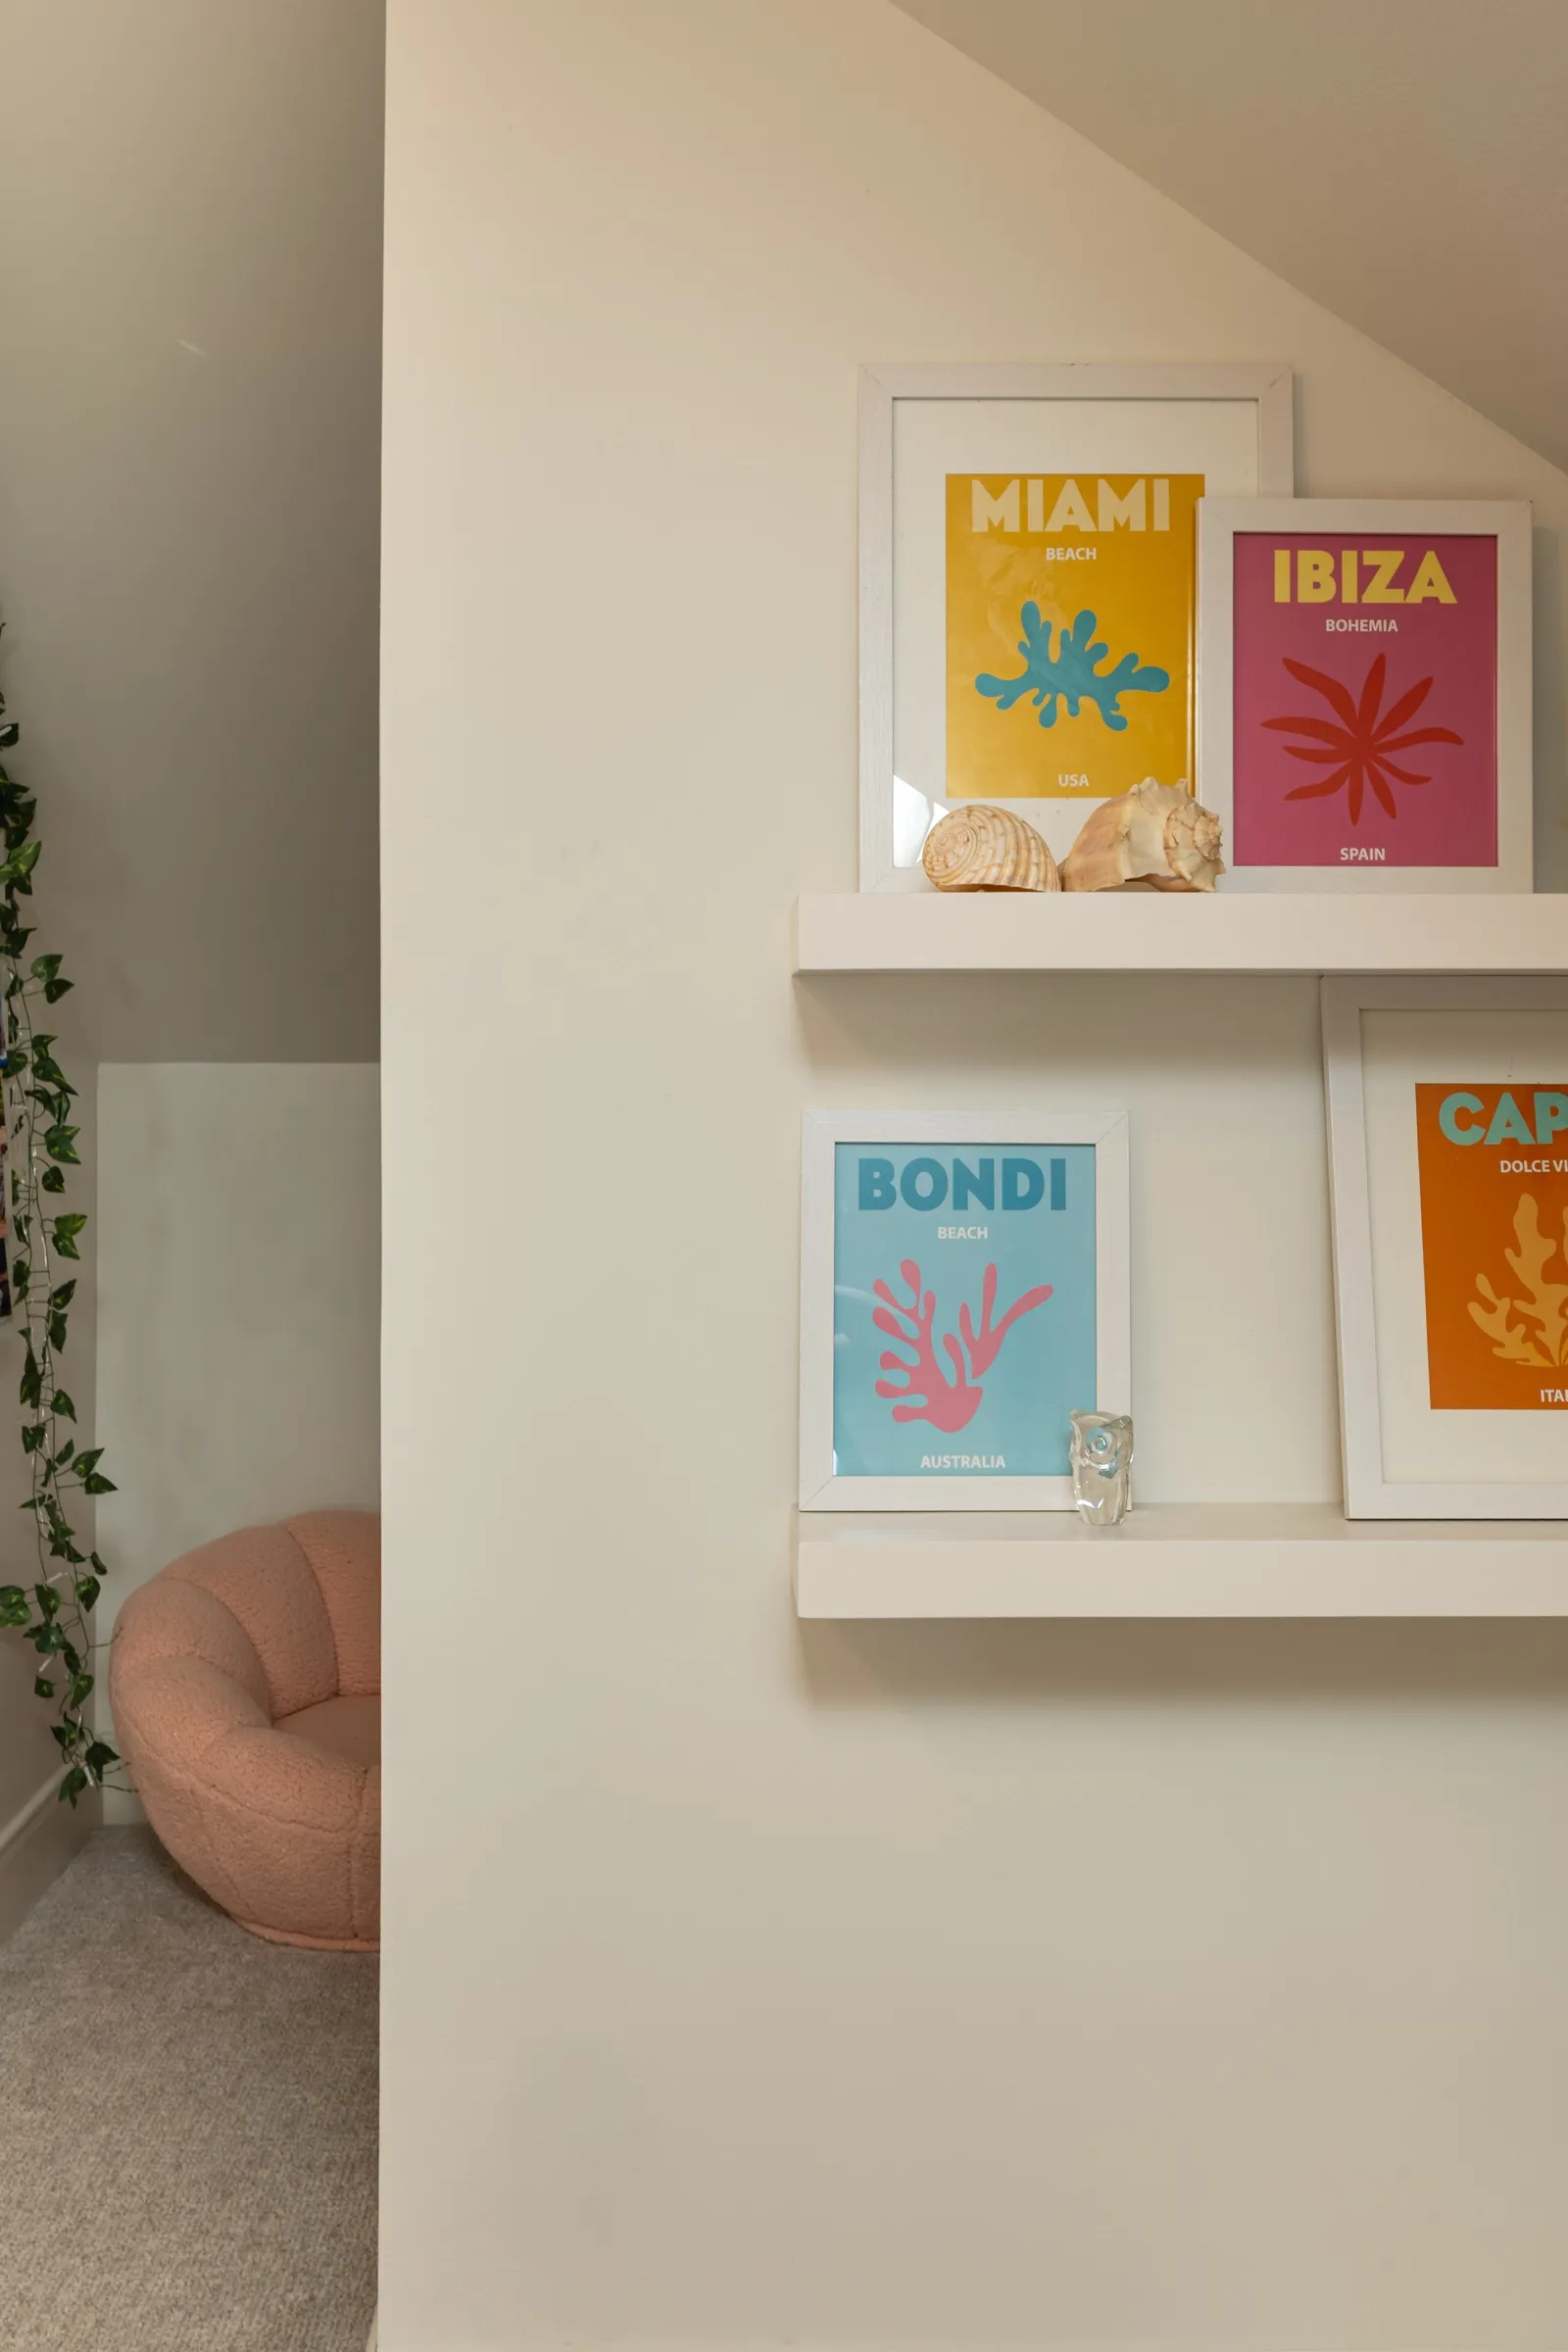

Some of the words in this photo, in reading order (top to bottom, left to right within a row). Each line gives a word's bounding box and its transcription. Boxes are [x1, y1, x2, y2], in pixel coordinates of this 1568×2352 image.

[970, 478, 1170, 532] MIAMI
[1045, 547, 1098, 562] BEACH
[1274, 549, 1457, 605] IBIZA
[1325, 618, 1399, 633] BOHEMIA
[1057, 773, 1090, 788] USA
[1340, 847, 1386, 861] SPAIN
[1499, 1159, 1550, 1173] DOLCE
[858, 1157, 1067, 1211] BONDI
[937, 1226, 989, 1240] BEACH
[920, 1454, 1006, 1469] AUSTRALIA
